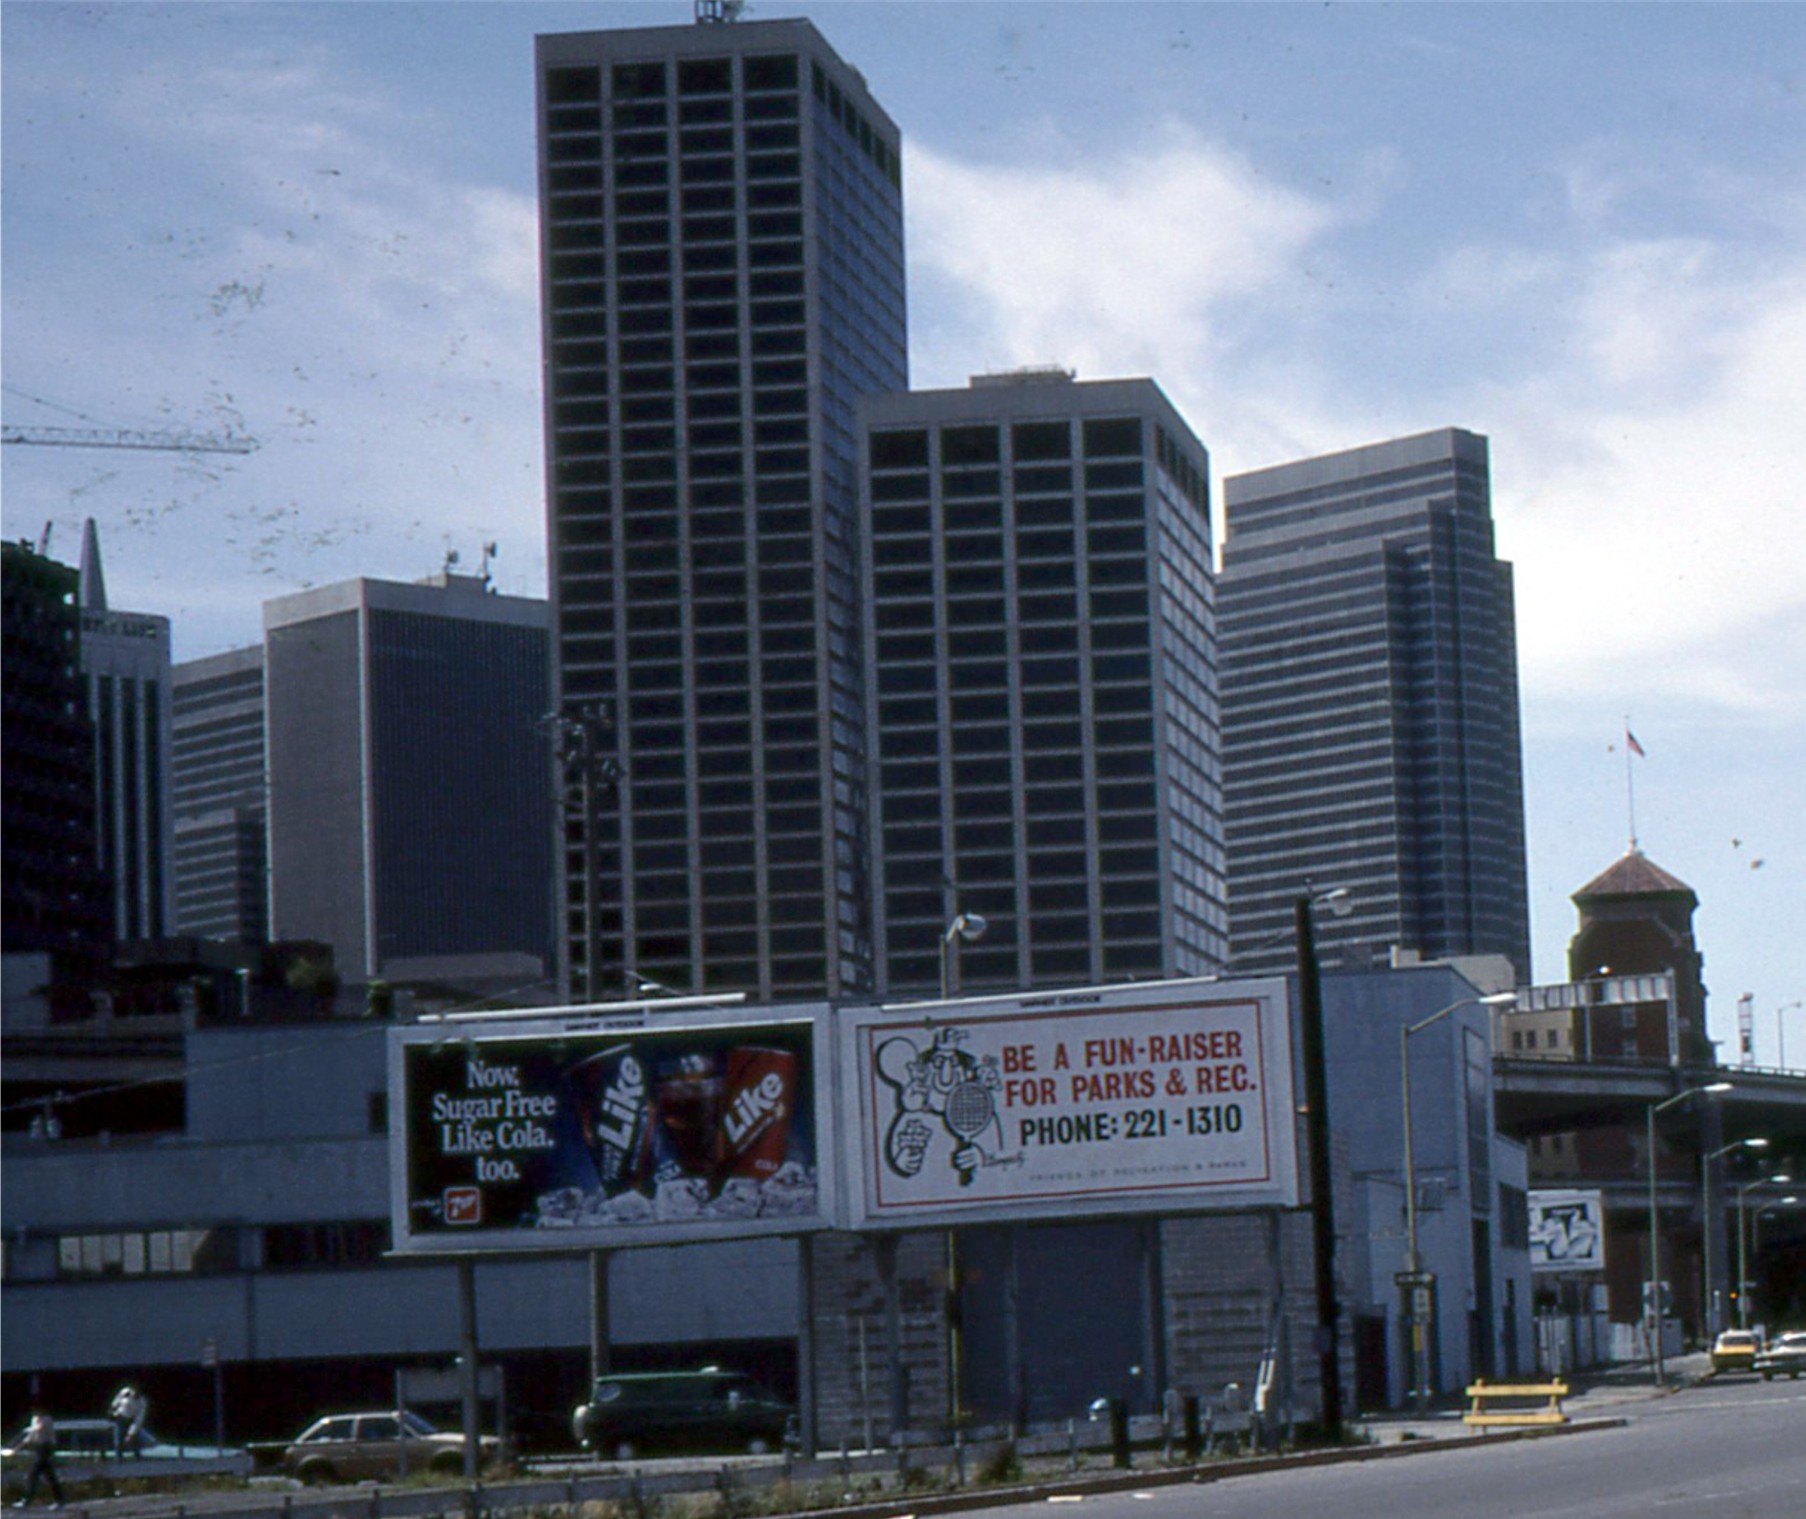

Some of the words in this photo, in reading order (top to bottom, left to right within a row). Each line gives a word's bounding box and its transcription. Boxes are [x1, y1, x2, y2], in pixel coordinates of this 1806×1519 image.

[1002, 1045, 1036, 1073] BE
[1054, 1042, 1070, 1070] A
[1084, 1030, 1243, 1068] FUN-RAISER
[467, 1060, 520, 1089] Now.
[1005, 1078, 1057, 1107] FOR
[1072, 1071, 1156, 1102] PARKS
[1165, 1067, 1188, 1096] &
[1196, 1063, 1257, 1095] REC.
[432, 1093, 503, 1125] Sugar
[504, 1089, 557, 1117] Free
[597, 1055, 645, 1150] Like
[723, 1072, 784, 1143] Like
[441, 1123, 493, 1152] Like
[496, 1120, 555, 1149] Cola.
[1020, 1112, 1119, 1147] PHONE:
[476, 1155, 520, 1182] too.
